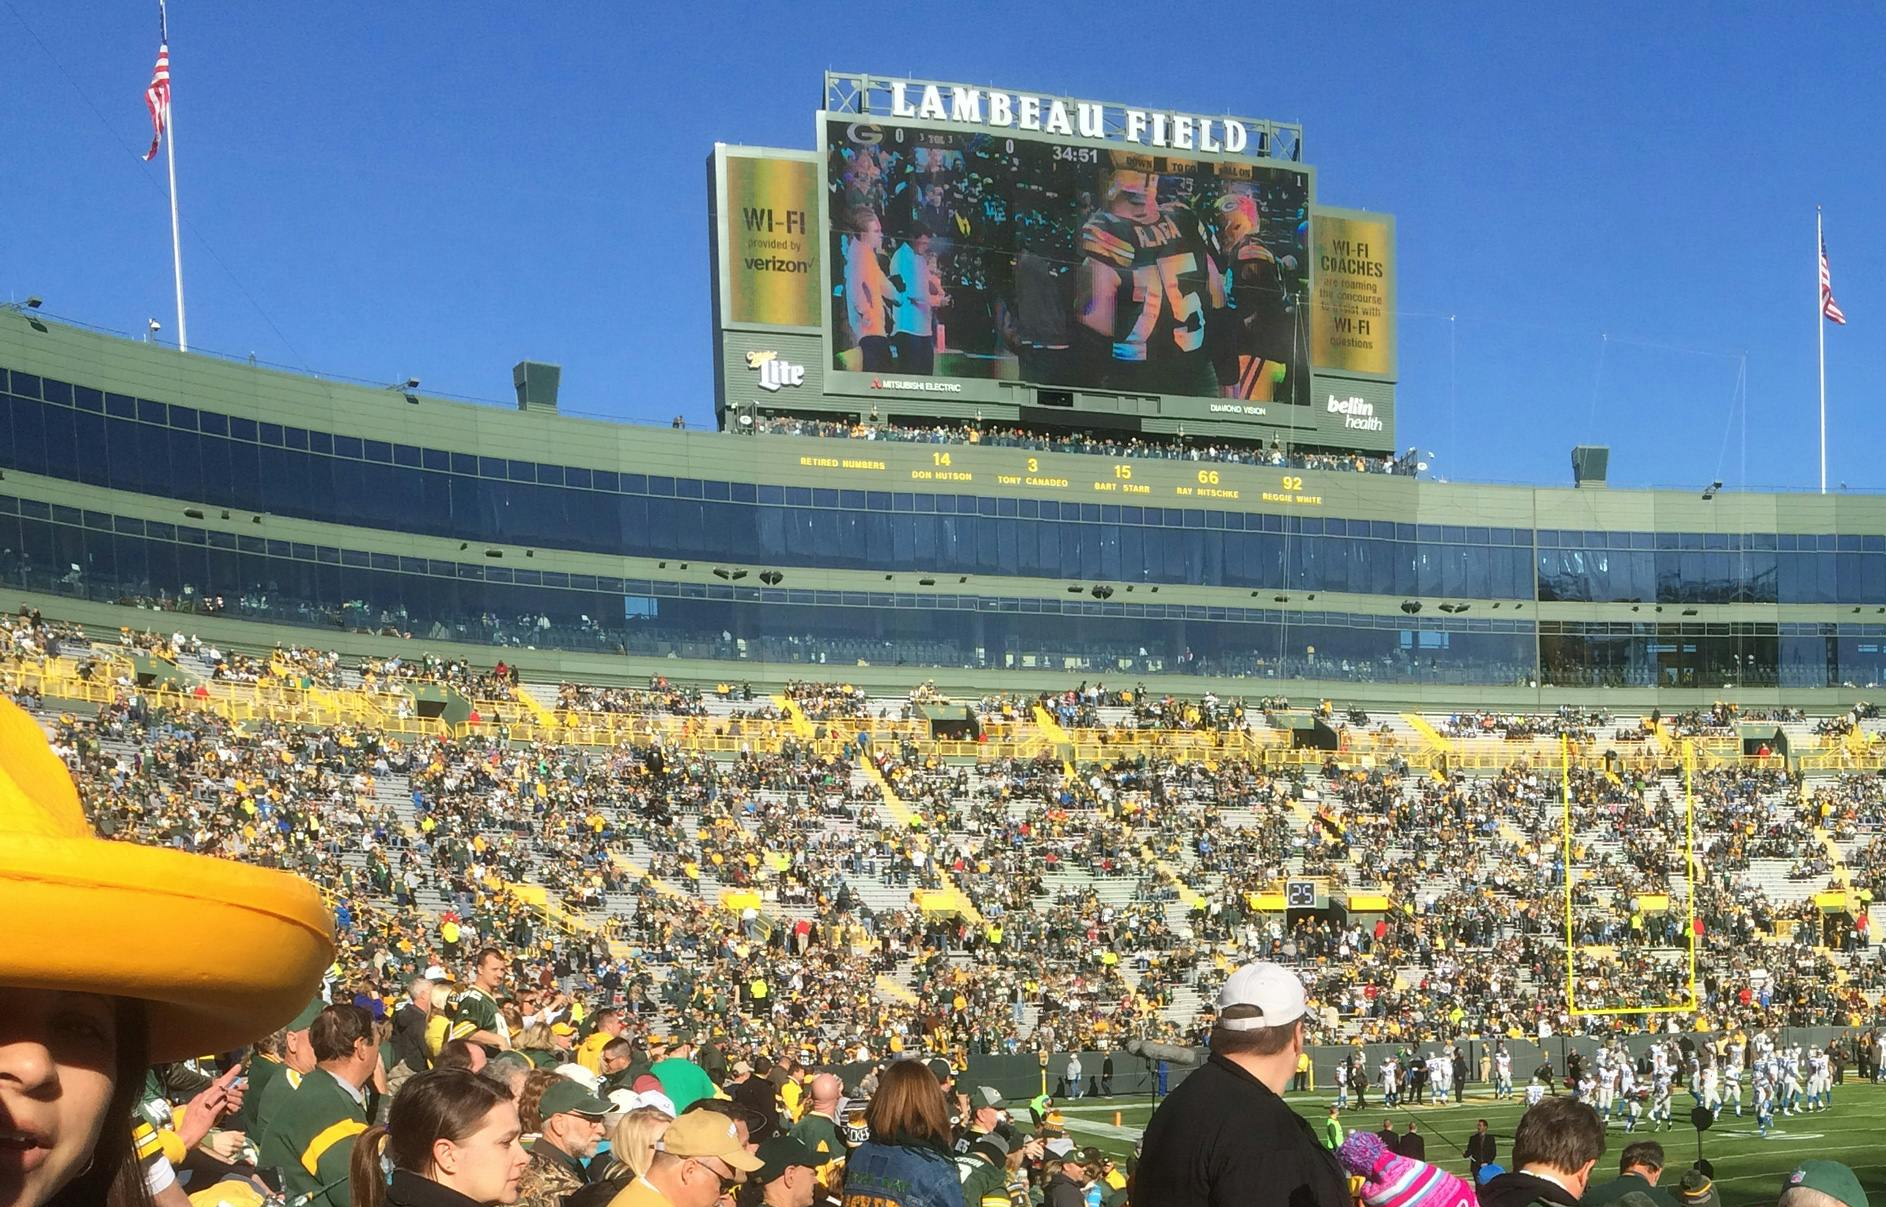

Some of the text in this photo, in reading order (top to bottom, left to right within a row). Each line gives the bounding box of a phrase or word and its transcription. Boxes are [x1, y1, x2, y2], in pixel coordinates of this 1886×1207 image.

[891, 81, 1248, 154] LAMBEAU FIELD
[1052, 146, 1098, 164] 34:51
[743, 208, 805, 235] WI-FI
[748, 238, 801, 252] provided by
[1333, 239, 1368, 258] WI-FI
[745, 256, 808, 273] verizon
[1321, 256, 1383, 278] COACHES
[1341, 280, 1377, 294] roaming
[1334, 318, 1370, 335] WI-FI
[1330, 337, 1373, 350] questions
[758, 360, 805, 392] Lite
[883, 380, 961, 393] MITSUBISHI ELECTRIC
[1210, 404, 1266, 415] DIAMOND VISION
[1327, 395, 1373, 416] bellin
[1345, 414, 1382, 431] health
[800, 457, 885, 470] RETIRED NUMBERS
[933, 452, 951, 467] 14
[1027, 458, 1038, 473] 3
[912, 470, 972, 481] DON HUTSON
[1114, 464, 1132, 479] 15
[1198, 470, 1220, 485] 66
[998, 475, 1069, 488] TONY CANADEO
[1094, 482, 1151, 494] BART STARR
[1283, 476, 1303, 490] 92
[1176, 486, 1239, 499] RAY NITSCHKE
[1262, 492, 1322, 505] REGGIE WHITE
[1290, 885, 1313, 904] 25
